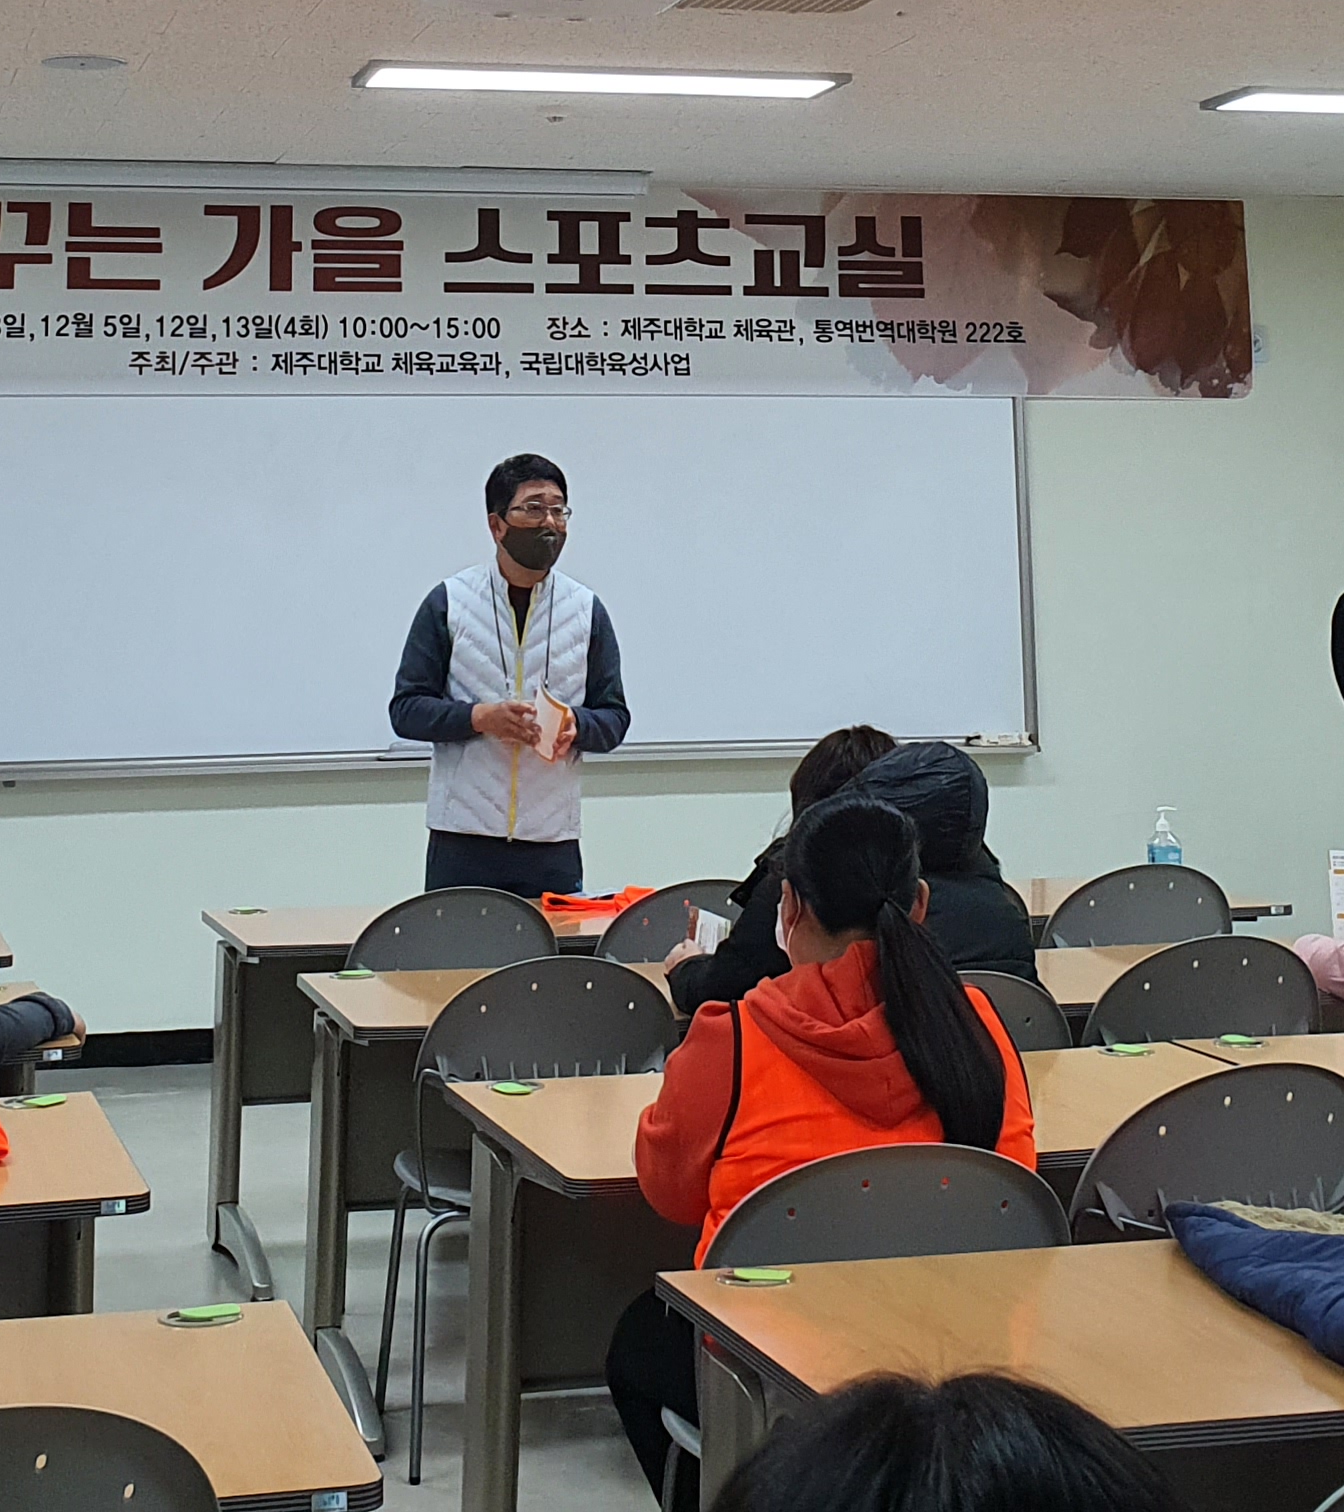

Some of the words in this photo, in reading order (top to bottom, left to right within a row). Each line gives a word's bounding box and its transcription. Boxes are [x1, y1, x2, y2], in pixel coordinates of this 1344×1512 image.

[203, 204, 404, 292] 가을
[443, 207, 926, 299] 스포츠교실
[339, 316, 500, 339] 10:00~15:00
[546, 316, 591, 340] 장소
[621, 317, 726, 342] 제주대학교
[733, 317, 804, 347] 체육관,
[813, 319, 958, 345] 통역번역대학원
[965, 321, 1026, 343] 222호
[128, 351, 239, 376] 주최/주관
[270, 351, 384, 376] 제주대학교
[391, 351, 510, 379] 체육교육과,
[520, 352, 691, 376] 국립대학육성사업
